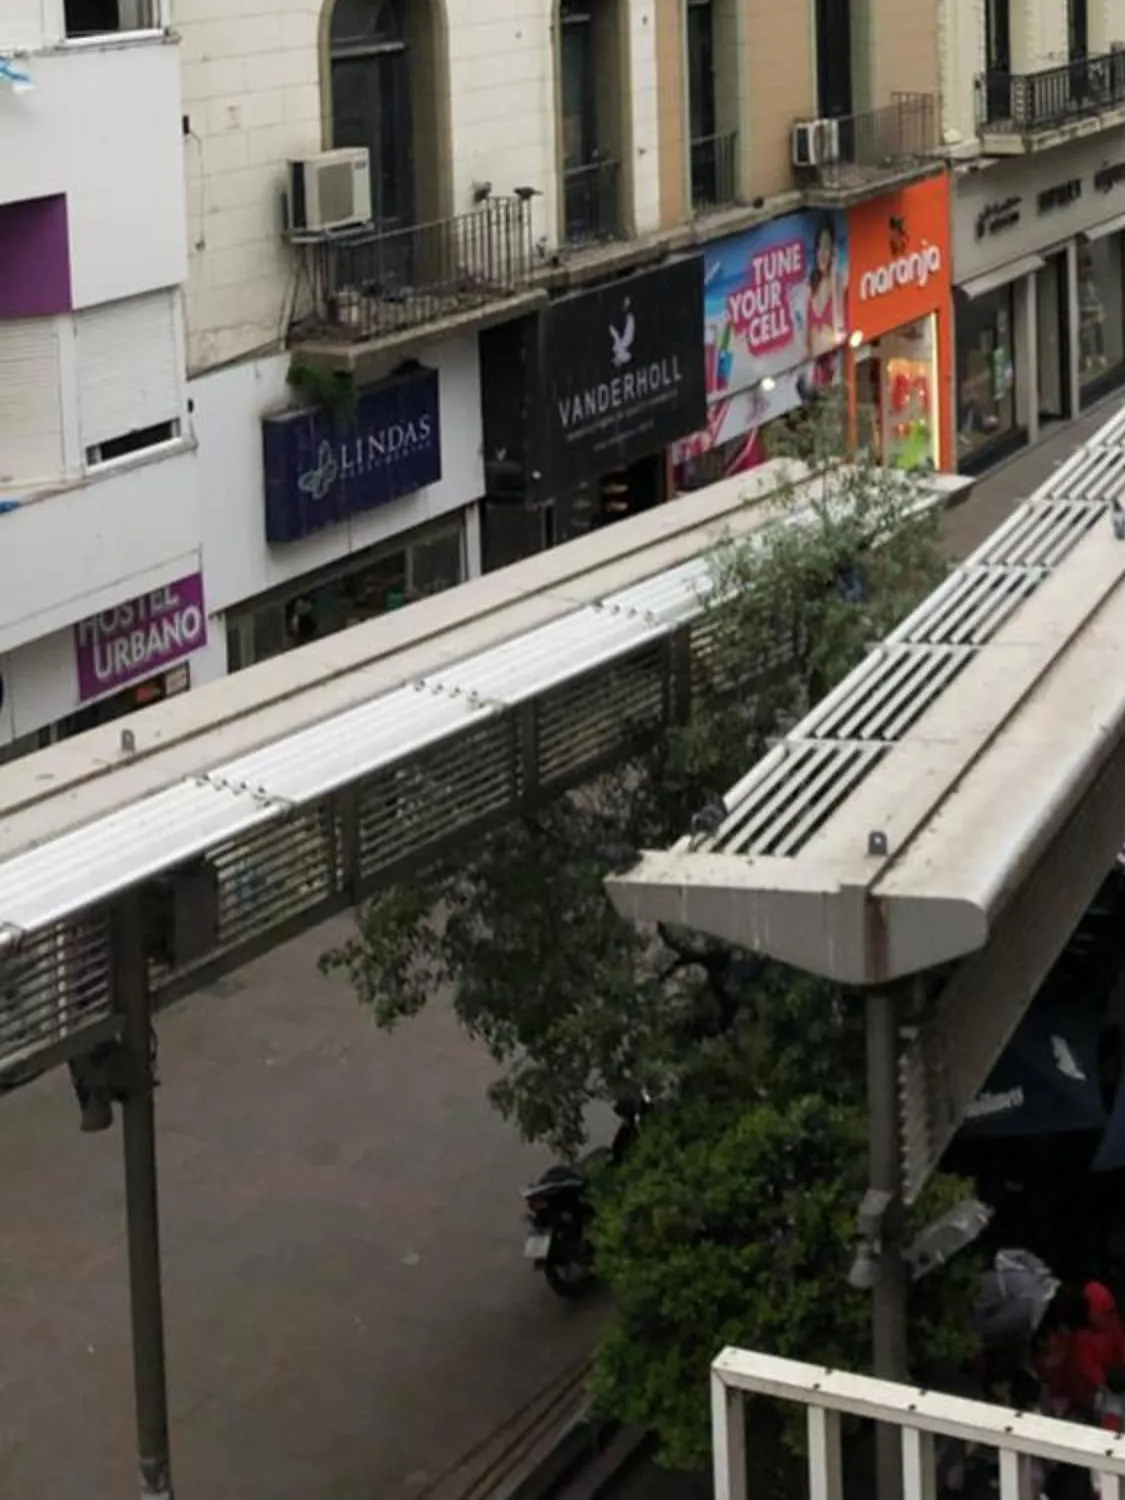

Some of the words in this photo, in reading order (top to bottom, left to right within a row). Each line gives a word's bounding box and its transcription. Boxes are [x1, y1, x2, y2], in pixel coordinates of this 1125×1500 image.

[752, 243, 802, 285] TUNE
[860, 238, 941, 301] naranja
[728, 280, 782, 323] YOUR
[748, 308, 791, 347] CELL
[558, 355, 682, 428] VANDERHOLL
[341, 413, 431, 469] LINDAS
[92, 604, 202, 680] URBANO
